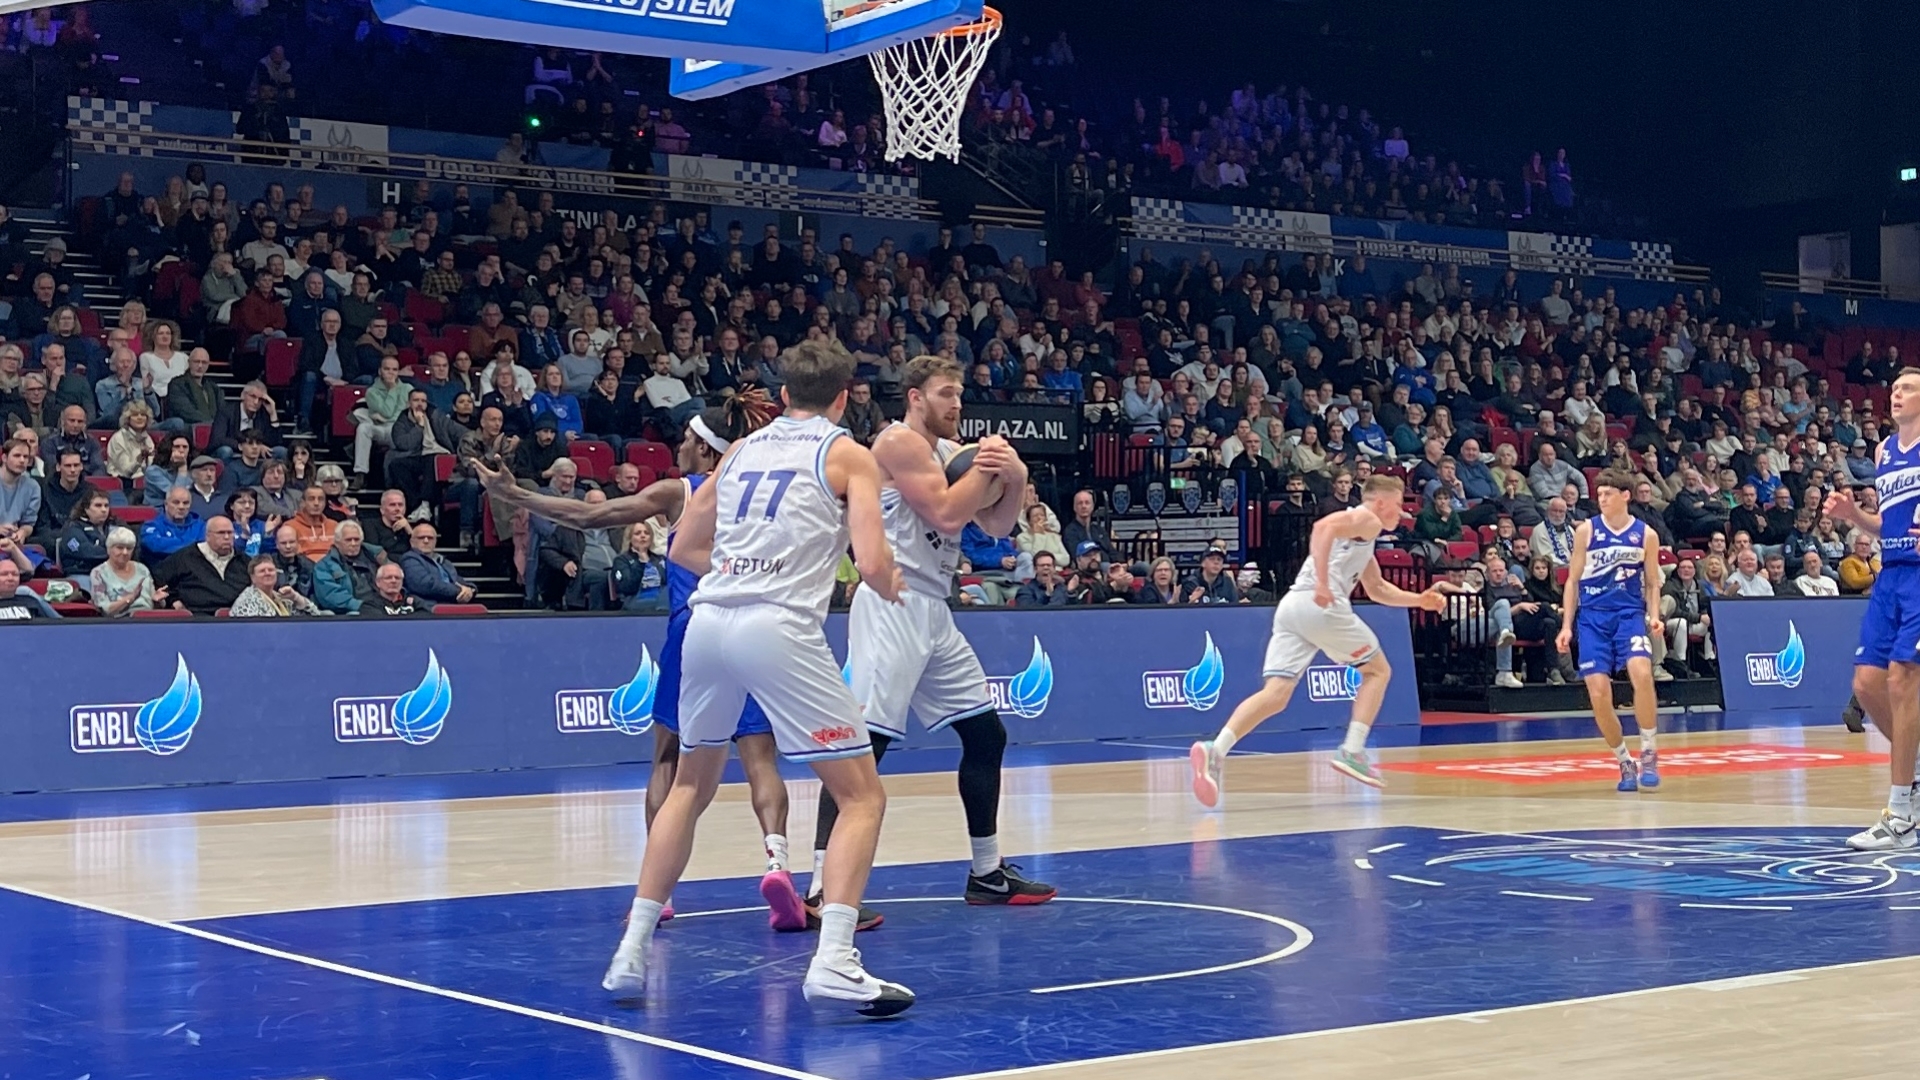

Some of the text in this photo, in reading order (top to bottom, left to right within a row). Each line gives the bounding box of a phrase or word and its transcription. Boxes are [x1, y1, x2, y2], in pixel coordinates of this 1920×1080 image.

[381, 181, 400, 204] H
[1333, 258, 1346, 277] K
[1845, 299, 1859, 316] M
[734, 470, 797, 524] 77
[1748, 658, 1779, 682] ENBL
[1147, 676, 1185, 704] ENBL
[1311, 671, 1347, 697] ENBL
[990, 685, 1010, 710] BL
[339, 703, 393, 737] ENBL
[561, 695, 611, 727] ENBL
[76, 711, 136, 747] ENBL
